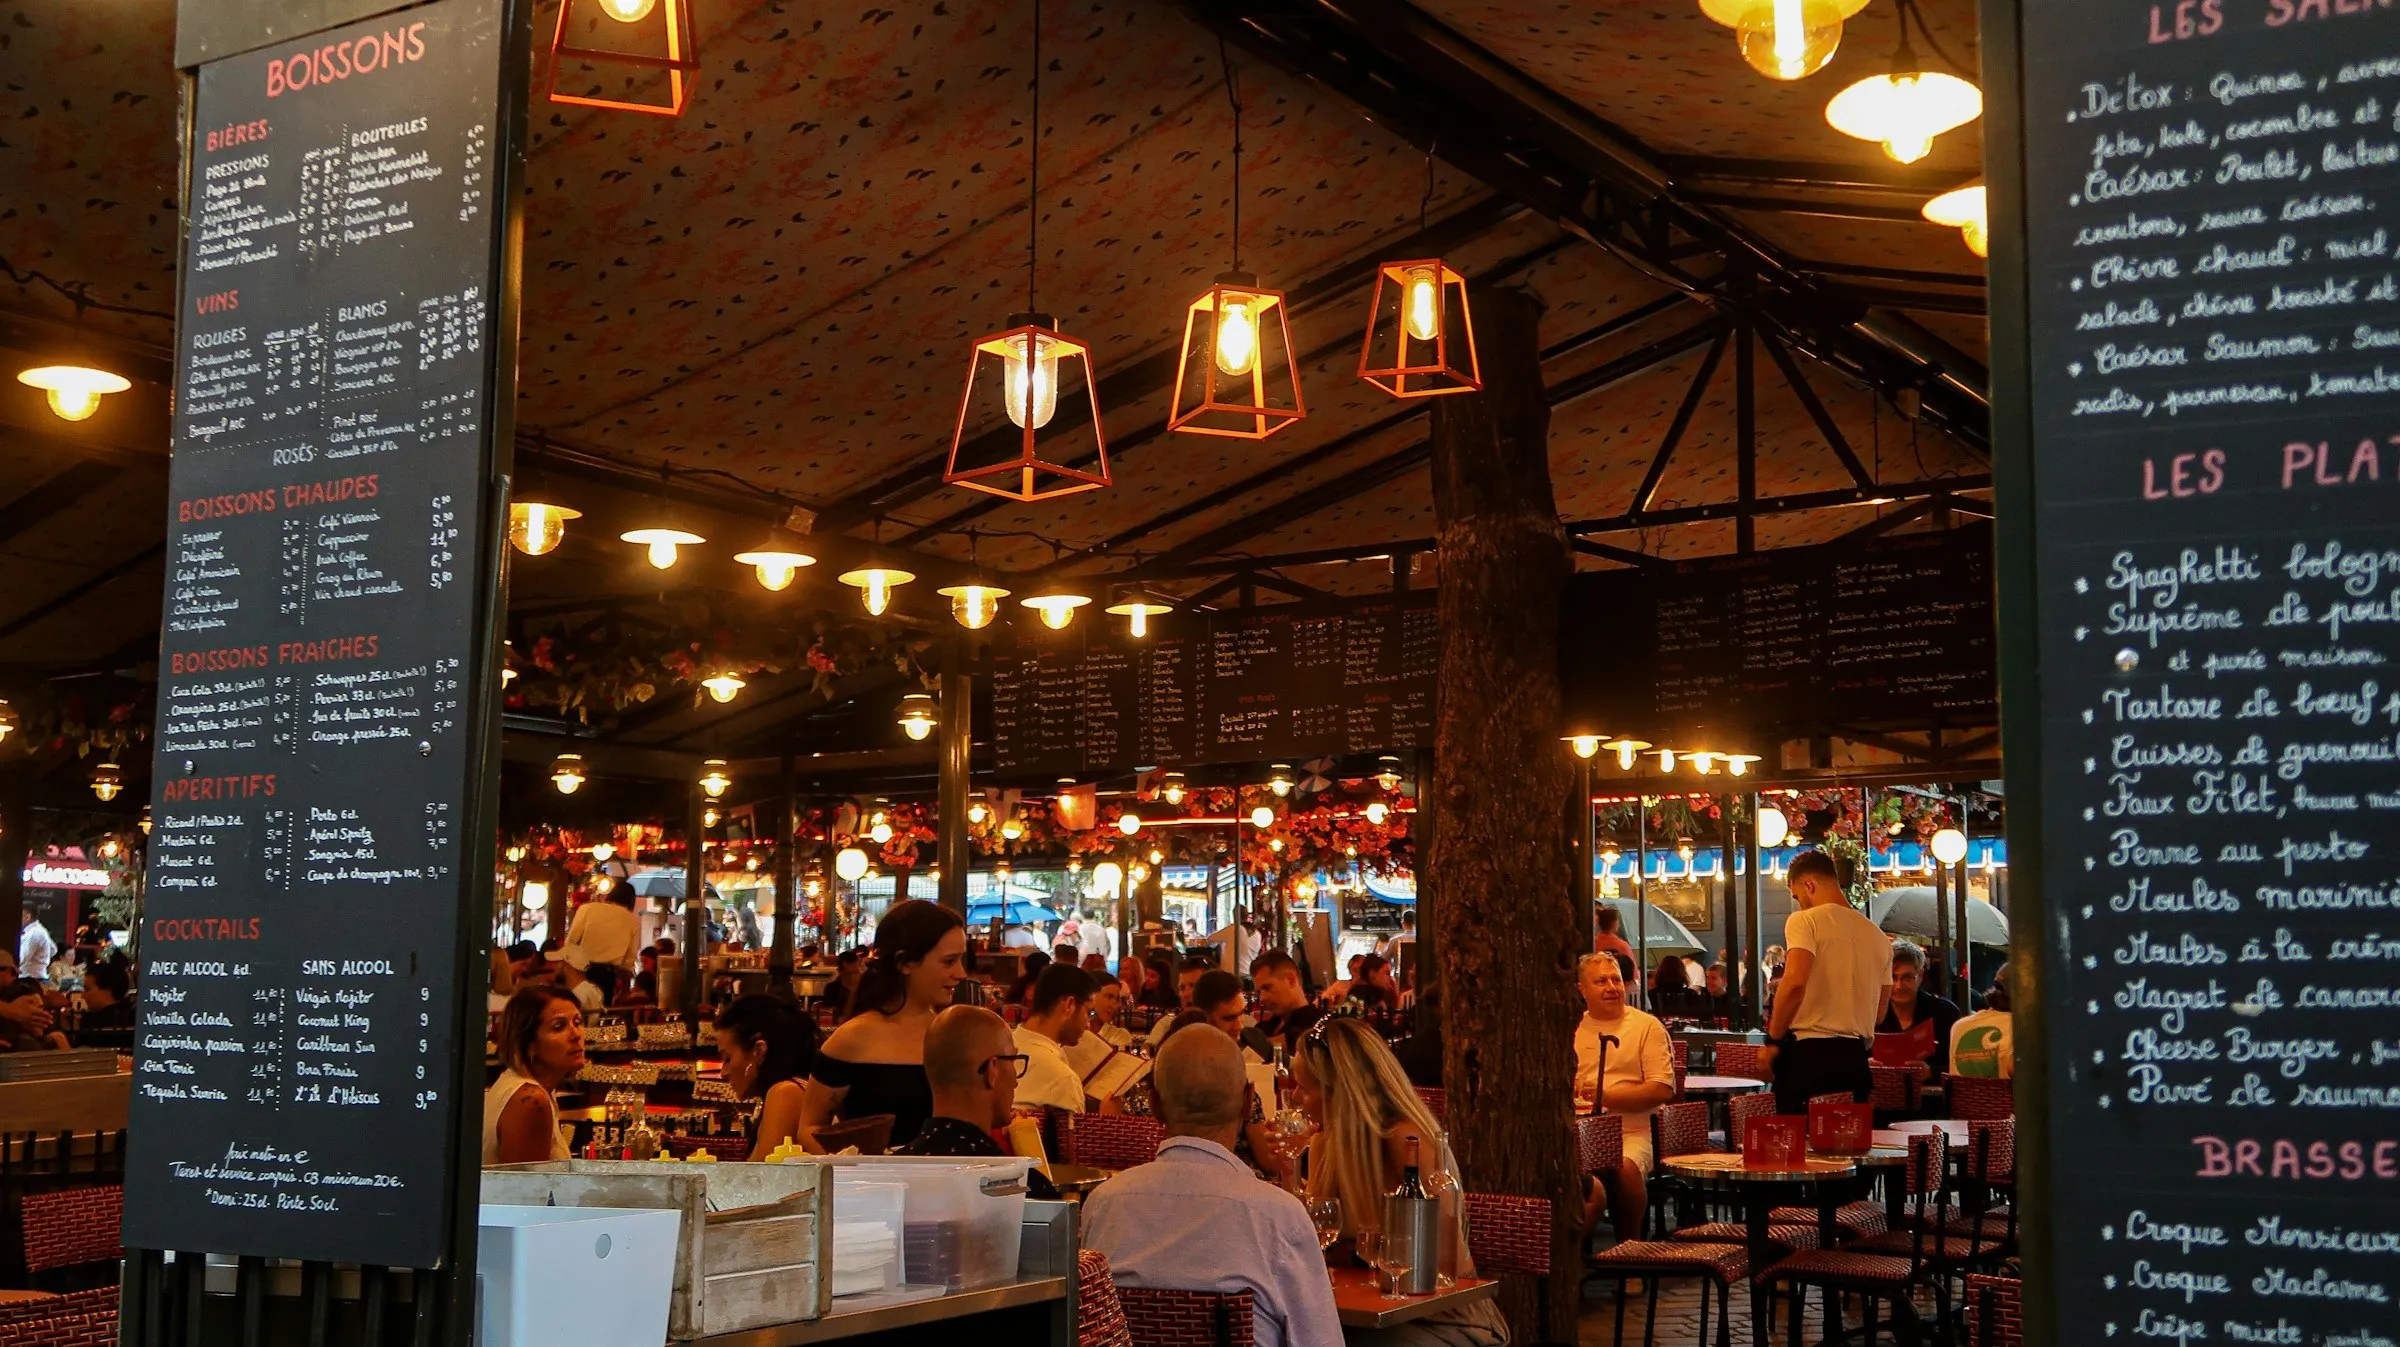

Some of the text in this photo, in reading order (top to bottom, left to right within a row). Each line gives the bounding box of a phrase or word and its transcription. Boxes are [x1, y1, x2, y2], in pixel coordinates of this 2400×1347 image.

[2147, 0, 2224, 44] LES
[267, 23, 425, 97] BOISSONS
[2352, 97, 2382, 124] et
[206, 119, 268, 152] BIÈRES
[351, 118, 428, 147] BOUTEILLES
[205, 154, 270, 180] PRESSIONS
[2196, 206, 2268, 233] sauce
[2324, 227, 2388, 259] miel
[196, 290, 239, 315] VINS
[2265, 277, 2360, 311] toasté
[2365, 273, 2399, 301] et
[338, 301, 388, 323] BLANCS
[193, 327, 247, 349] ROUGES
[2094, 342, 2189, 374] Caésar
[2142, 448, 2226, 500] LES
[179, 474, 379, 522] BOISSONS CHAUDES
[2105, 544, 2261, 609] Spaghetti
[2263, 592, 2310, 626] de
[172, 635, 379, 674] BOISSONS FRAICHES
[2168, 648, 2191, 672] et
[2101, 683, 2223, 722] Tartare
[2235, 686, 2281, 720] de
[312, 731, 349, 745] Orange
[2110, 734, 2223, 769] Cuisses
[2230, 733, 2270, 765] de
[162, 774, 276, 802] APERITIFS
[2102, 770, 2175, 816] Faux
[311, 807, 338, 822] Porto
[162, 835, 196, 847] Martini
[2107, 828, 2370, 877] Penne au pesto
[160, 855, 194, 867] Muscat
[309, 849, 353, 863] Sangria
[160, 875, 199, 891] Campari
[307, 867, 403, 884] Coupe de champagne
[2109, 876, 2240, 912] Moules
[153, 917, 261, 942] COCKTAILS
[2114, 930, 2228, 966] Moules
[2272, 927, 2312, 962] la
[149, 961, 178, 976] AVEC
[182, 962, 228, 976] ALCOOL
[302, 960, 394, 976] SANS ALCOOL
[150, 985, 187, 1007] Mojito
[296, 987, 429, 1009] Virgin Mojito 9
[2114, 976, 2226, 1034] Magret
[2244, 976, 2284, 1008] de
[147, 1011, 233, 1027] Vanilla Colada
[298, 1013, 428, 1033] Coconut King 9
[205, 1037, 245, 1056] passion
[297, 1035, 427, 1053] Caribbean Sun 9
[2121, 1027, 2221, 1061] Cheese
[143, 1060, 195, 1074] Gin Tonic
[296, 1061, 425, 1079] Bora Fraise 9
[143, 1083, 228, 1103] Tequila Sunrise
[2127, 1063, 2213, 1104] Pavé
[2225, 1073, 2276, 1107] de
[249, 1145, 276, 1161] nets
[277, 1153, 292, 1162] en
[294, 1150, 310, 1164] €
[2191, 1134, 2400, 1180] BRASSE
[169, 1161, 202, 1178] Taxes
[203, 1163, 218, 1178] et
[218, 1167, 256, 1181] service
[303, 1172, 319, 1185] CB
[321, 1172, 373, 1185] minimum
[277, 1193, 307, 1211] Pinte
[2125, 1209, 2230, 1255] Croque
[2127, 1259, 2389, 1304] Croque Madame
